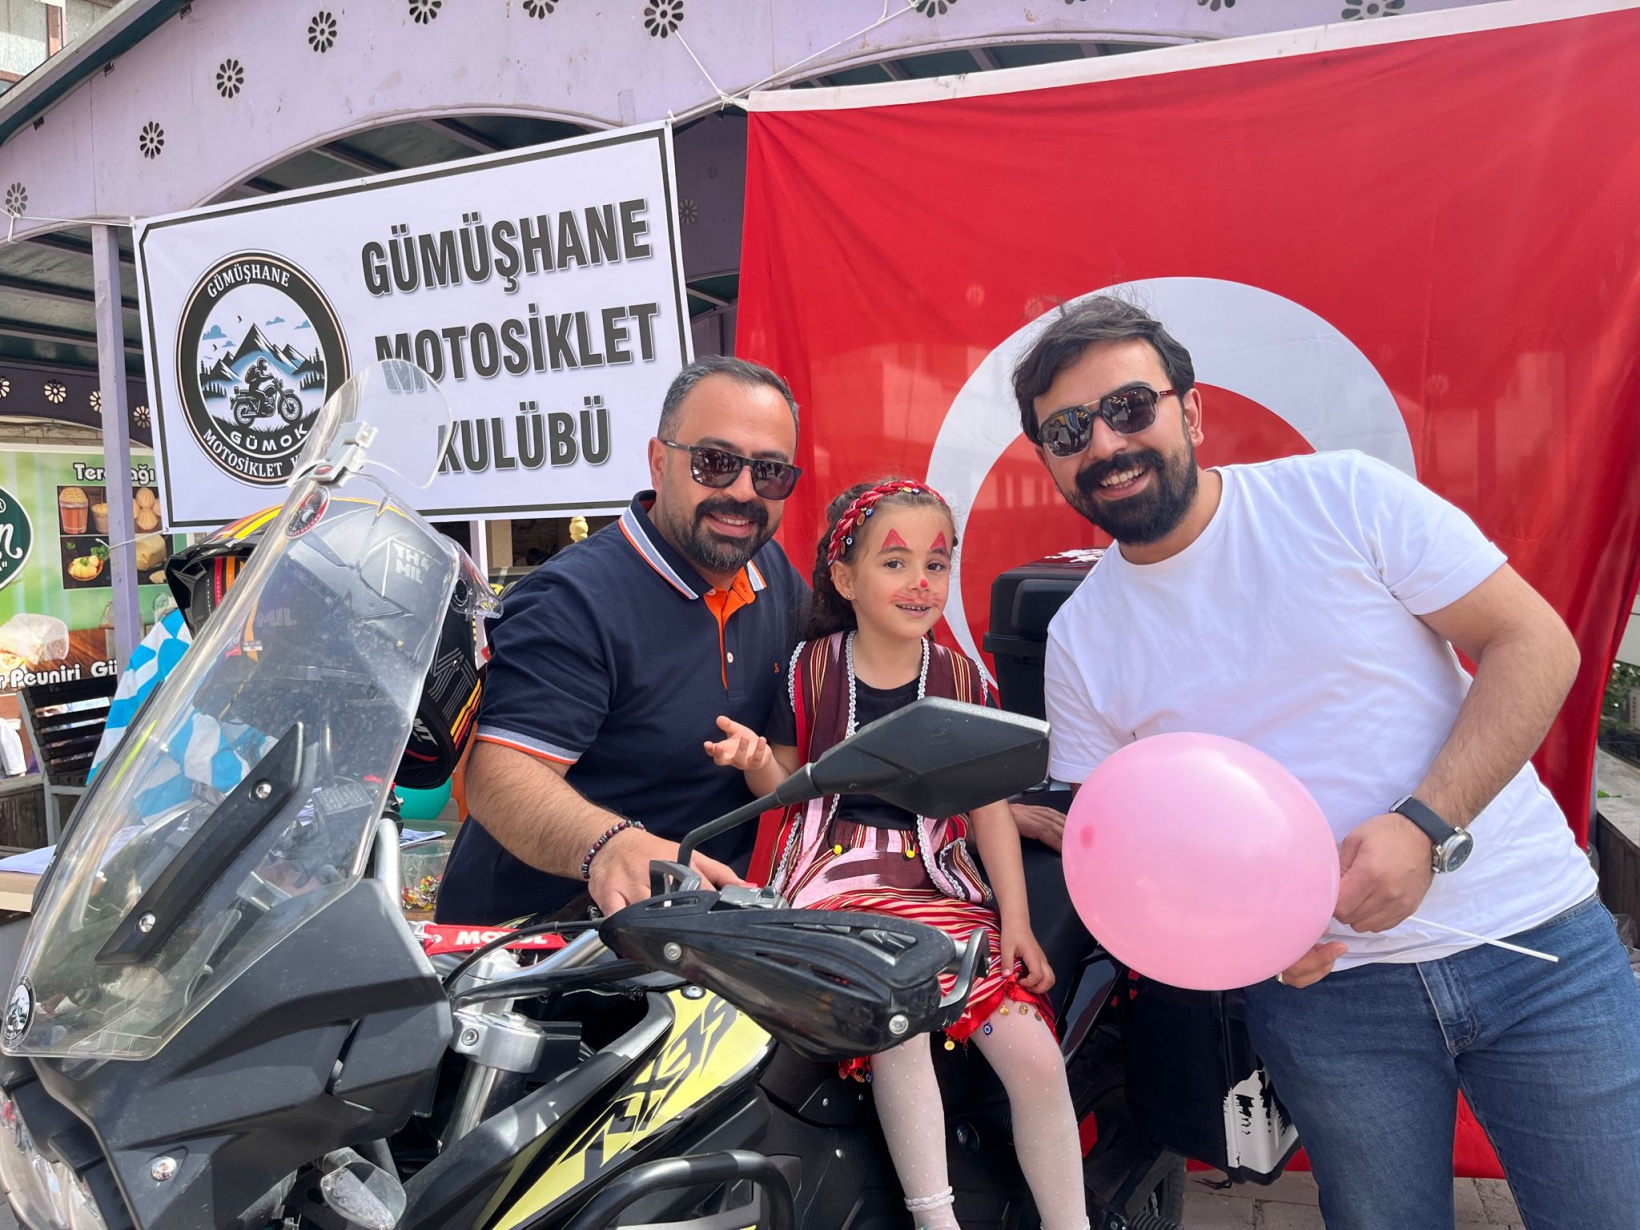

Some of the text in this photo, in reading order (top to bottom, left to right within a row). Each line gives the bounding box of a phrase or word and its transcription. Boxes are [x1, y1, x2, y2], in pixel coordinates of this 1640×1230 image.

[362, 198, 653, 296] GÜMÜŞHANE
[207, 264, 291, 298] GÜMÜŞHANE
[374, 303, 659, 393] MOTOSİKLET
[203, 428, 284, 478] MOTOSİKLET
[230, 428, 309, 452] GÜMOK
[437, 395, 612, 474] KULÜBÜ
[73, 462, 156, 486] Terağı
